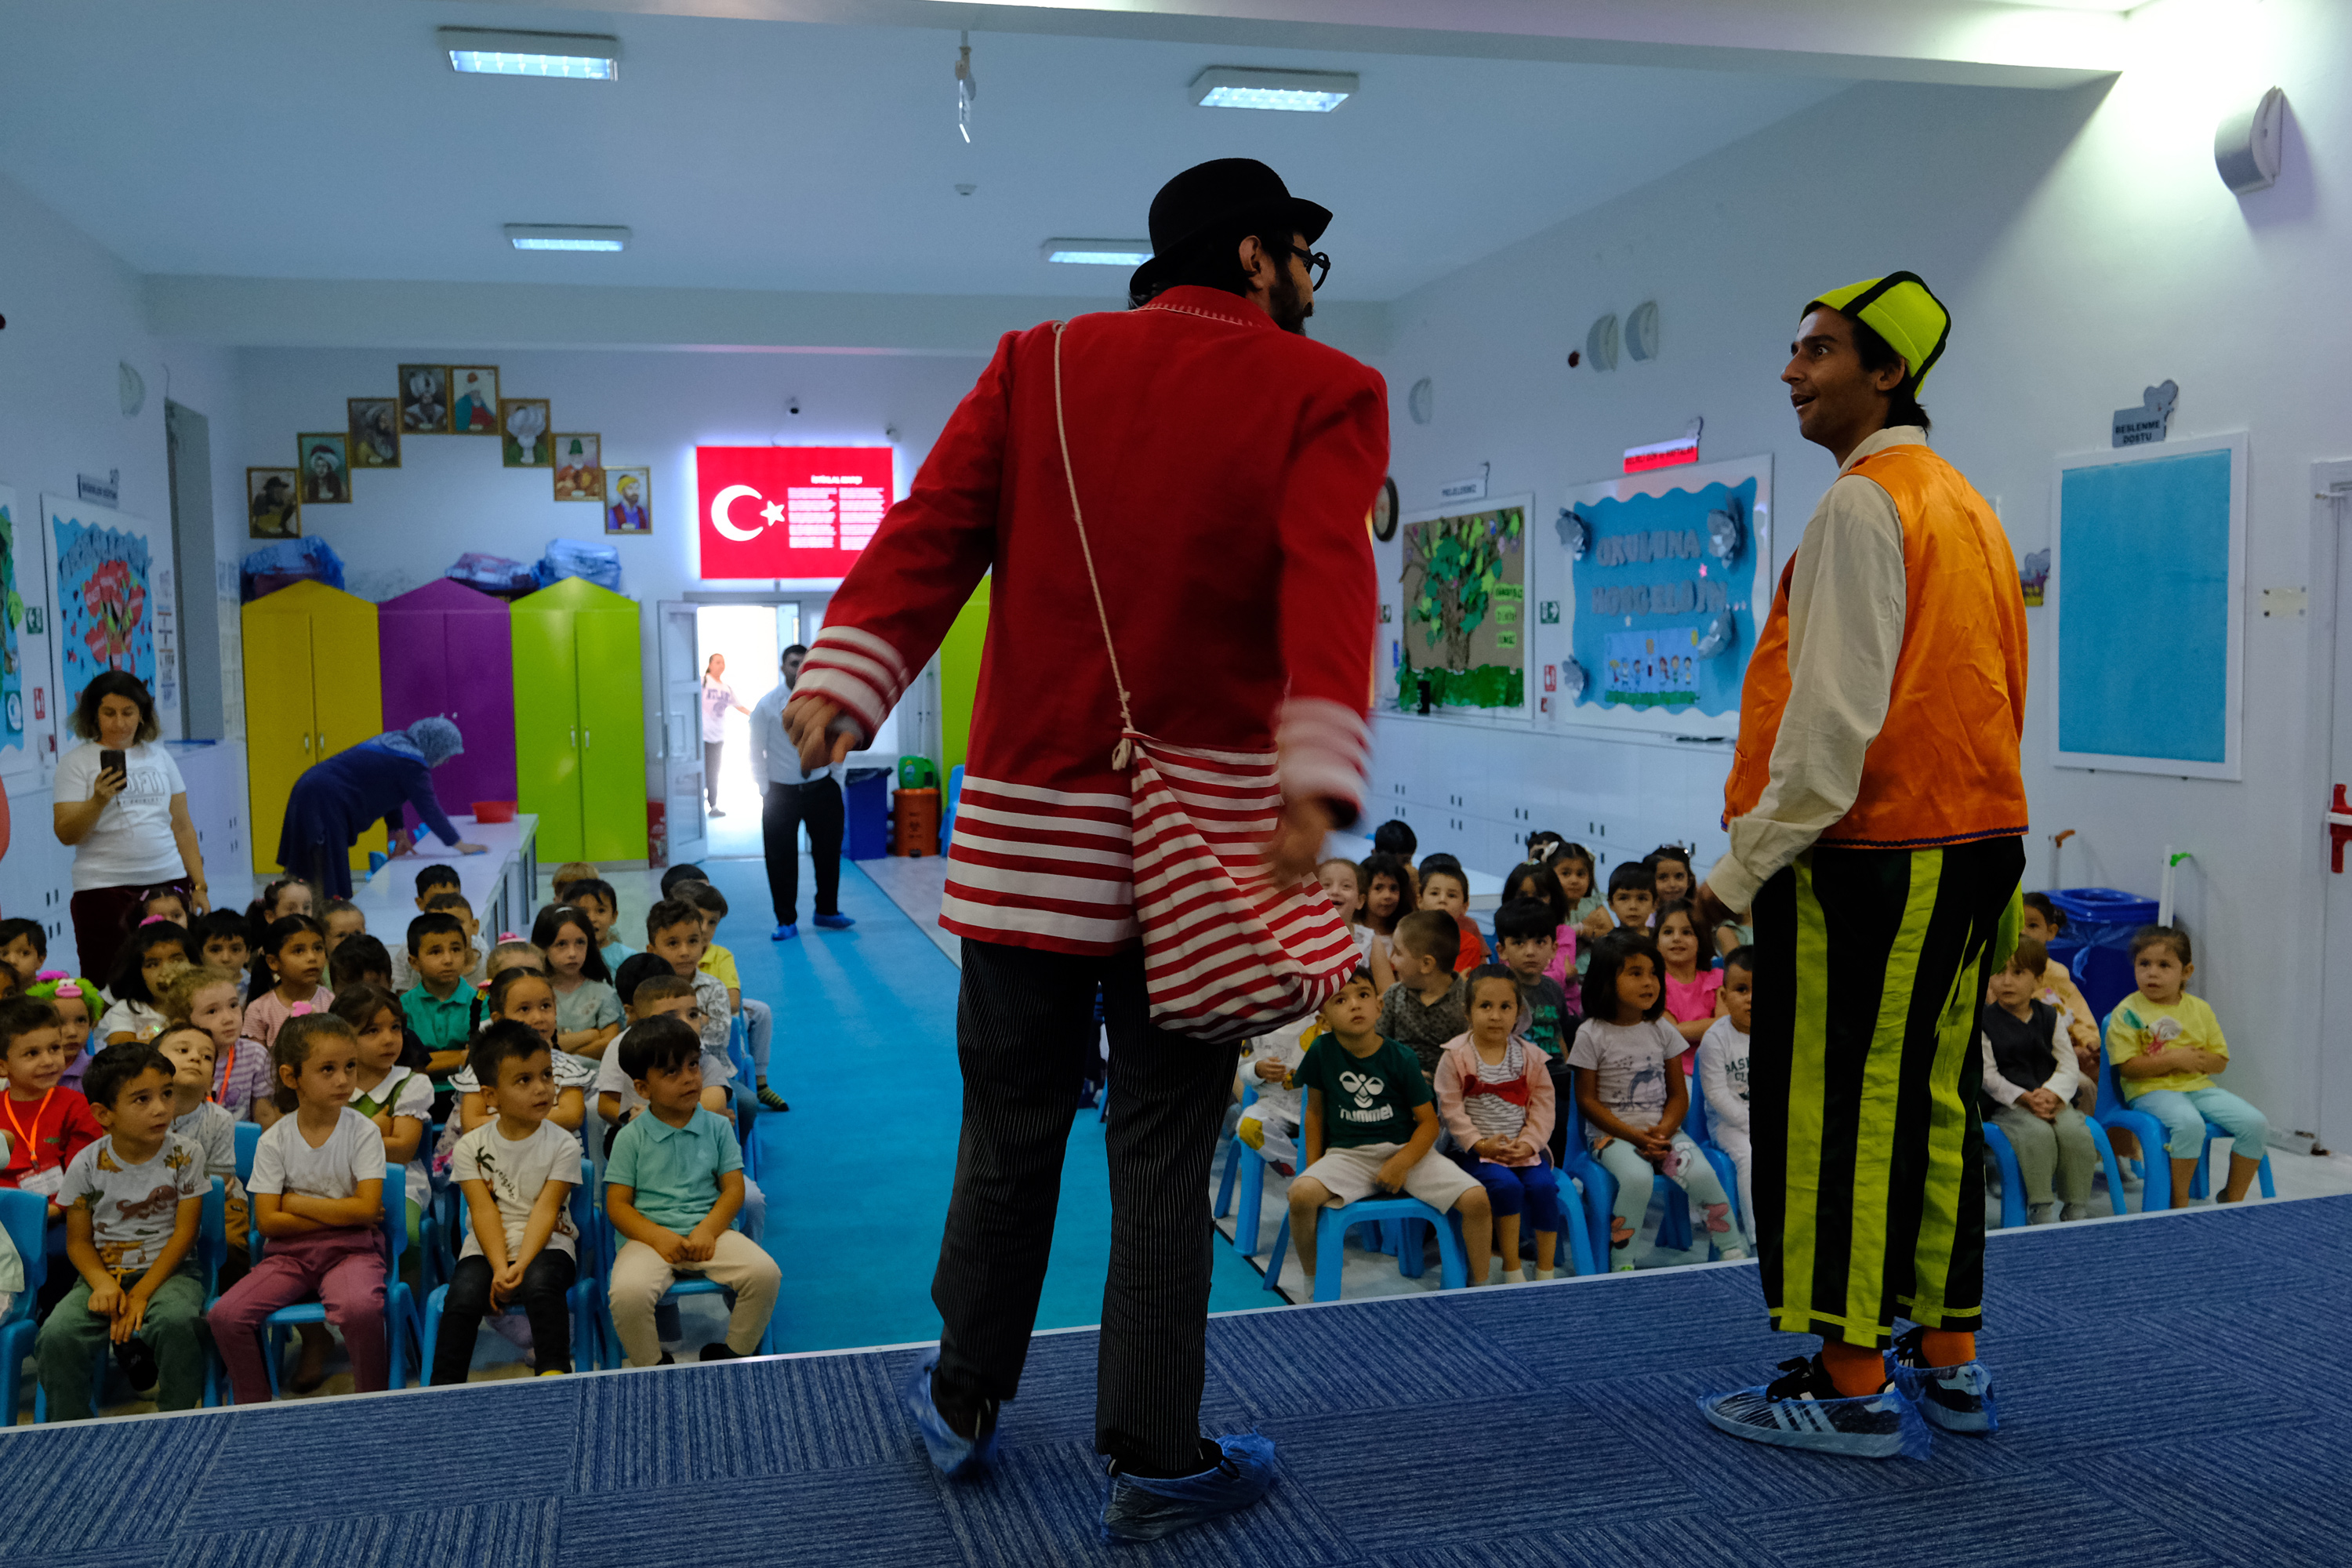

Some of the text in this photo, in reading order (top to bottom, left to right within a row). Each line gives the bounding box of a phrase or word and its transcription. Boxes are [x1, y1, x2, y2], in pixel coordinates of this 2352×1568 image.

[2115, 420, 2160, 434] BESLENME
[2123, 432, 2152, 444] DOSTU
[1338, 1102, 1394, 1123] hummel
